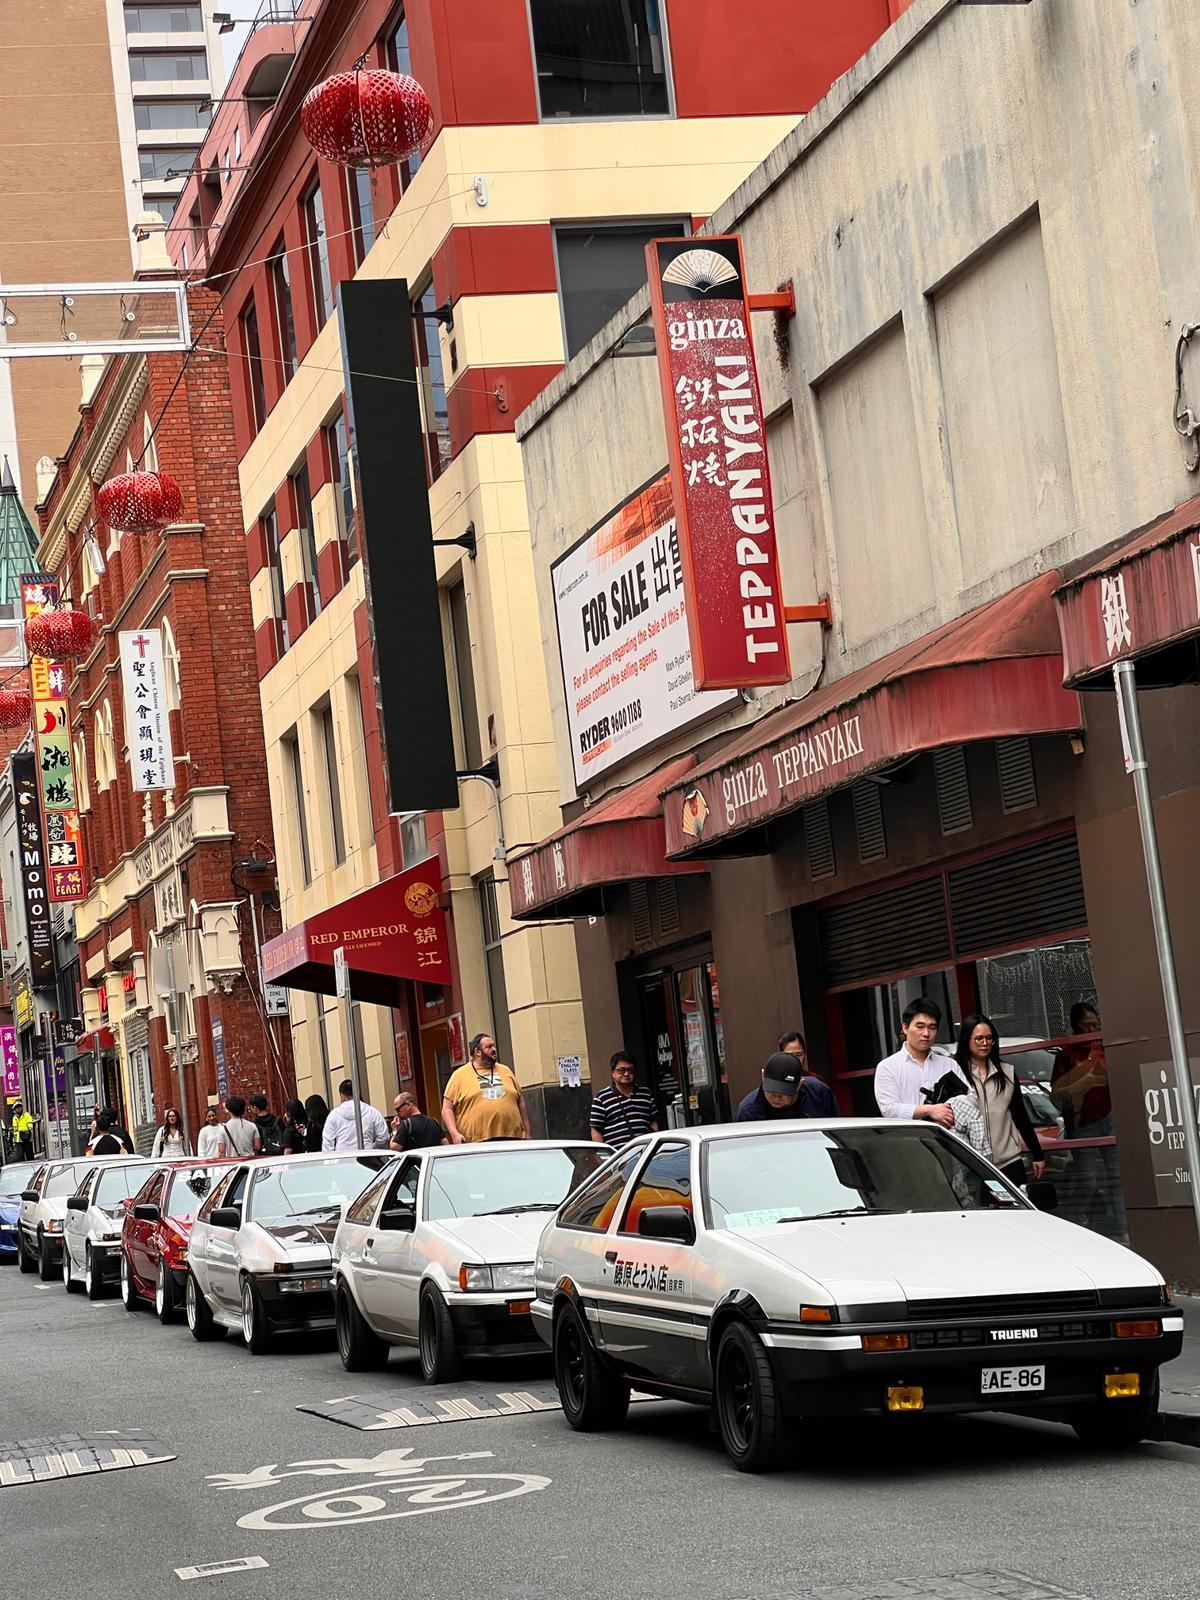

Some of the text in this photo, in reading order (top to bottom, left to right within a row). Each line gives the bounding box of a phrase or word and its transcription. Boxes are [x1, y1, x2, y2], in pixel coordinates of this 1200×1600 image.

[668, 312, 747, 351] ginza
[715, 355, 779, 664] TEPPANYAKI
[581, 591, 610, 653] FOR
[610, 560, 650, 632] SALE
[588, 652, 612, 679] enquiries
[612, 635, 637, 662] regarding
[637, 629, 648, 645] the
[647, 617, 661, 640] Sale
[660, 613, 668, 630] of
[668, 605, 680, 626] this
[575, 692, 592, 717] please
[591, 676, 612, 702] contact
[611, 671, 620, 688] the
[620, 661, 638, 682] selling
[638, 648, 658, 672] agents
[152, 687, 160, 709] Chinese
[158, 757, 166, 784] Epiphany
[579, 716, 611, 753] RYDER
[610, 707, 628, 735] 9600
[627, 698, 642, 725] 1188
[722, 715, 864, 826] ginza TEPPANYAKI
[24, 851, 44, 916] Momo
[56, 883, 81, 896] FEAST
[310, 923, 409, 946] RED EMPEROR
[413, 926, 442, 968] 錦江
[990, 1328, 1039, 1341] TRUENO
[302, 1480, 487, 1518] 20
